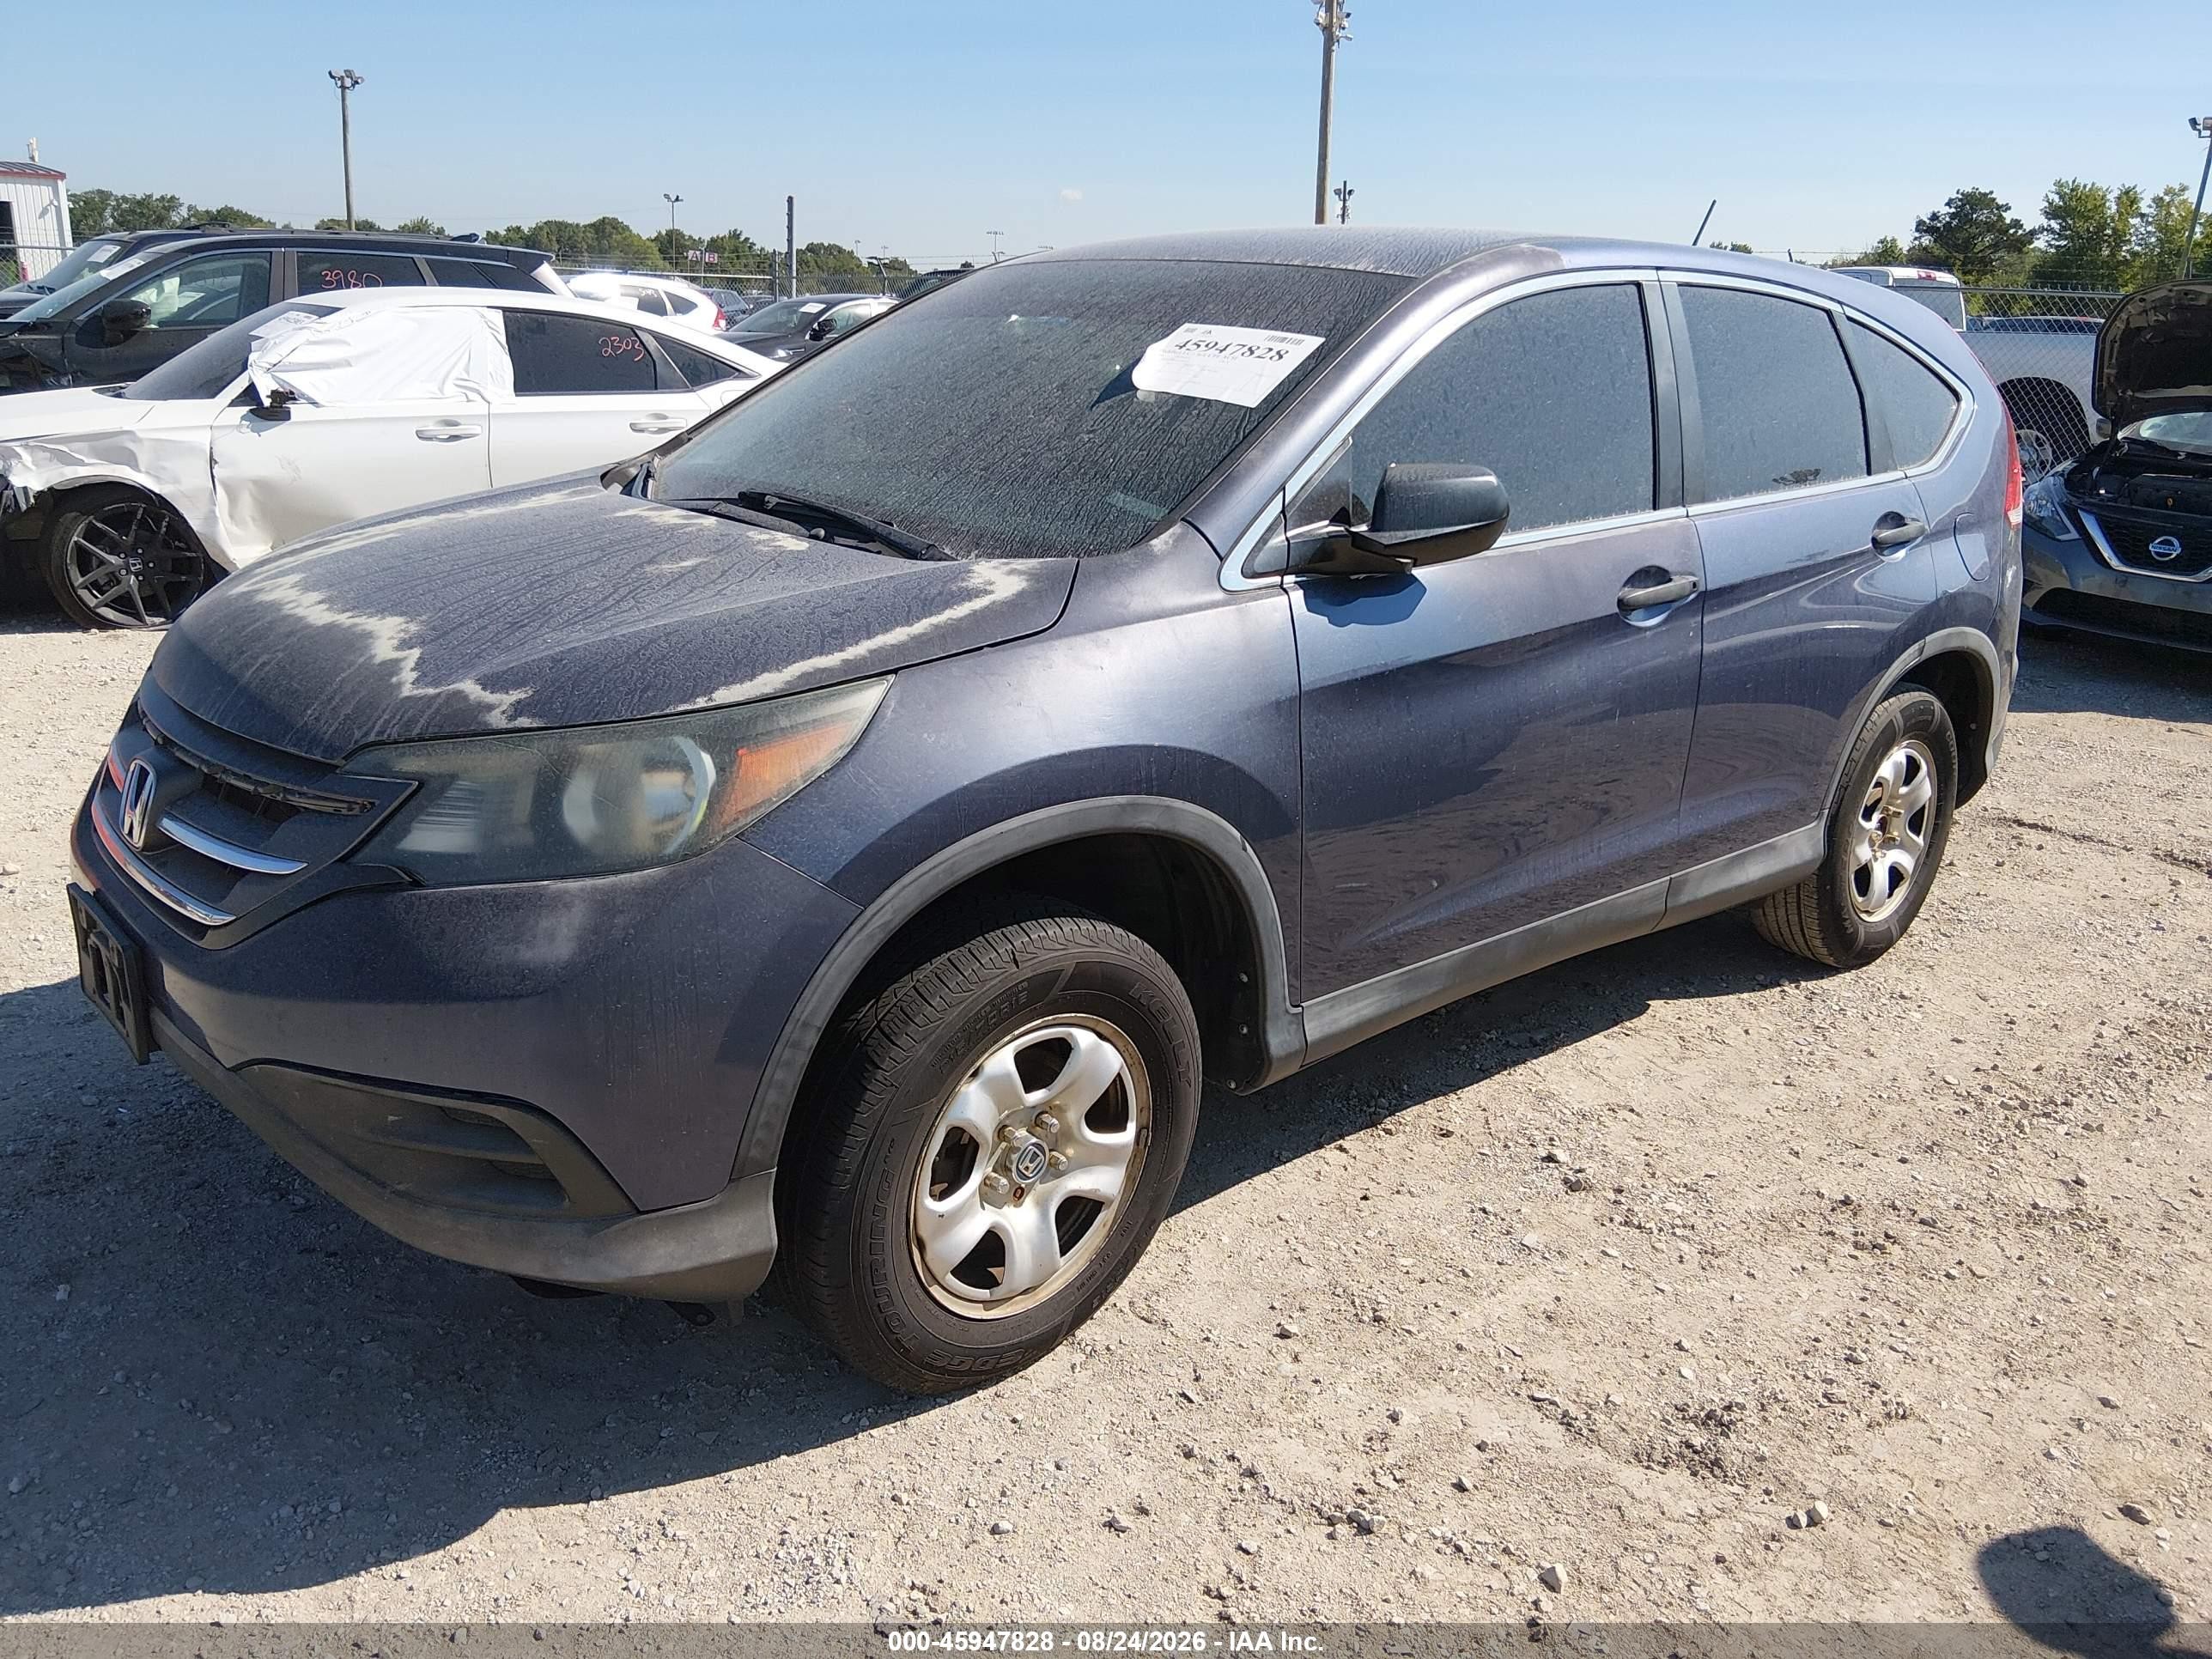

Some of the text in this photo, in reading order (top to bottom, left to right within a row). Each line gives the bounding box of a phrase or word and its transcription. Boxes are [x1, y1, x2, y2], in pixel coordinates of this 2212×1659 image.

[690, 250, 699, 261] A
[708, 252, 715, 262] B
[321, 270, 383, 289] 3980
[599, 337, 645, 362] 2303
[1175, 338, 1290, 362] 45947828
[2151, 544, 2179, 553] NISSAN
[1127, 981, 1192, 1088] KELLY
[870, 1168, 921, 1356] TOURING
[922, 1347, 1025, 1371] EDGE
